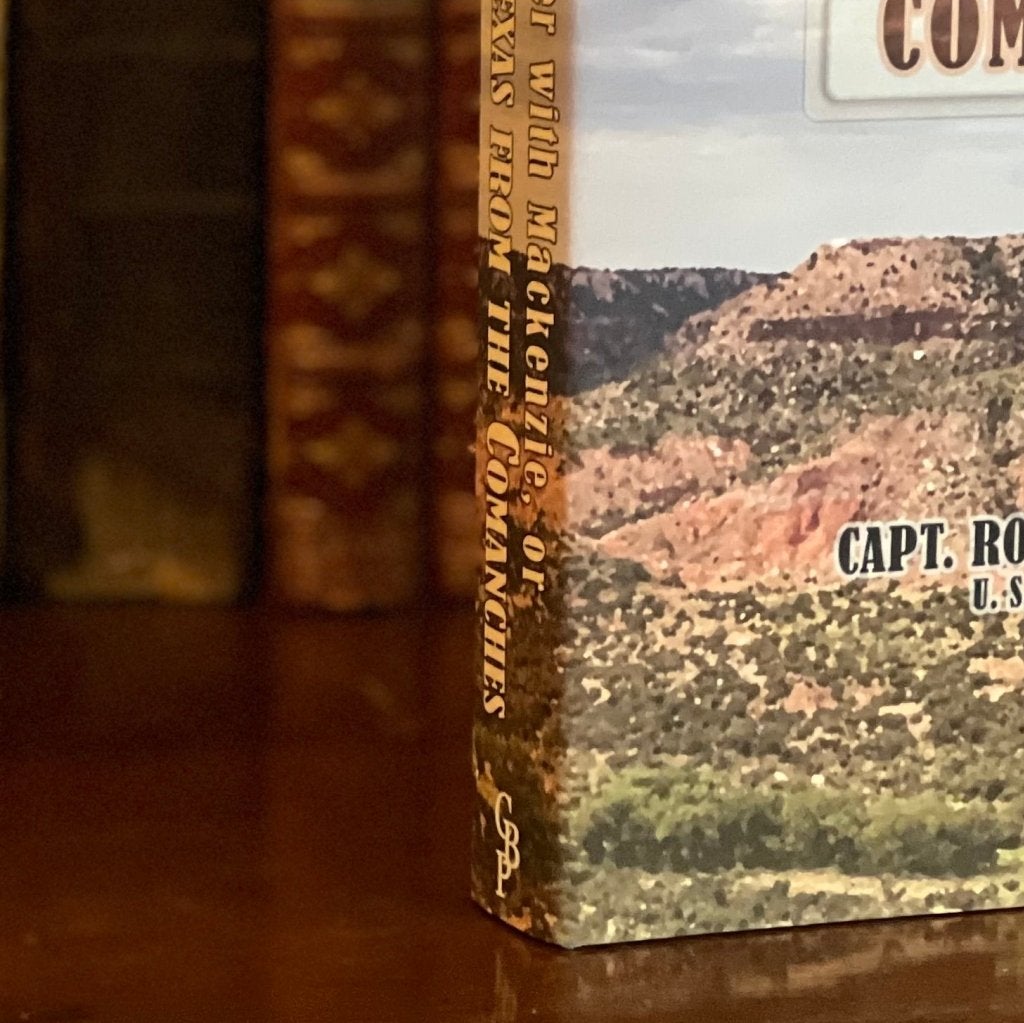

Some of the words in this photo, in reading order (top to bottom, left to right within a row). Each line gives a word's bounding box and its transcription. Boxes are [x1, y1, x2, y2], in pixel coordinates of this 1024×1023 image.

[528, 59, 561, 180] with
[487, 124, 514, 276] FROM
[487, 300, 511, 397] THE
[520, 200, 558, 504] Mackenzie,
[483, 422, 521, 719] COMANCHES
[522, 534, 546, 592] or
[837, 522, 953, 575] CAPT.
